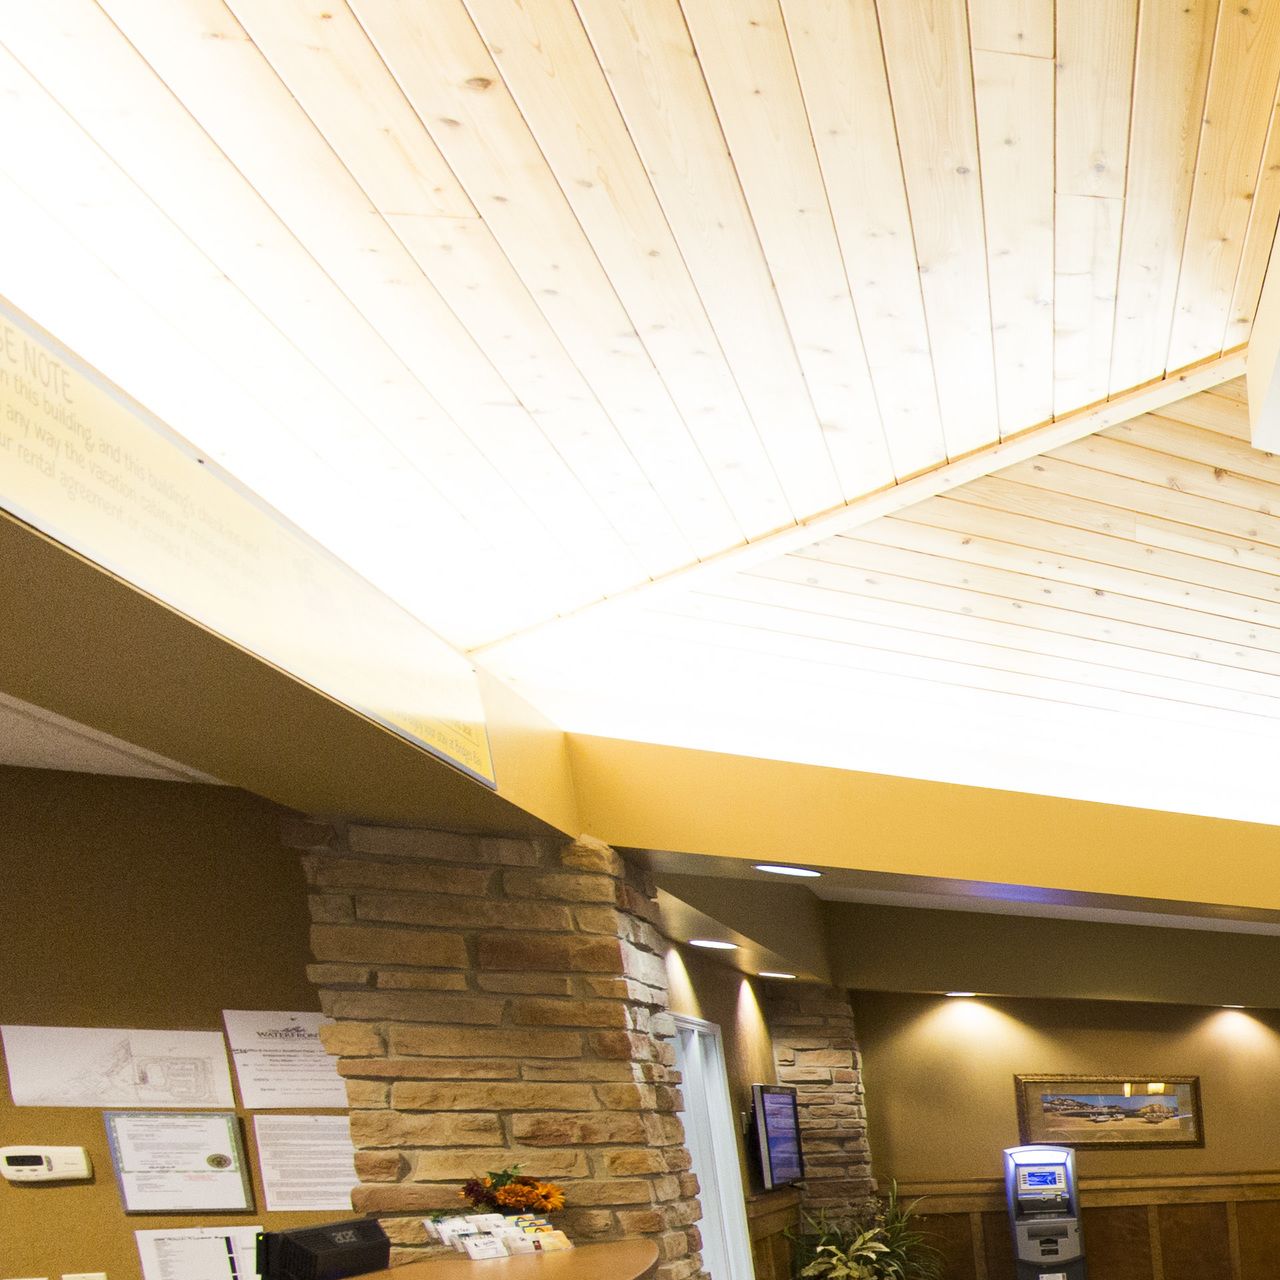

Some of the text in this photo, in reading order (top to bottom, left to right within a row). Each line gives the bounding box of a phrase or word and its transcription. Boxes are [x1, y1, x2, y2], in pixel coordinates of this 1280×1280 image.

[23, 340, 74, 405] NOTE
[6, 405, 31, 438] any
[32, 421, 61, 457] way
[64, 438, 85, 469] the
[88, 458, 137, 501] vacation
[14, 375, 40, 407] this
[98, 436, 121, 465] and
[124, 449, 146, 481] this
[18, 443, 56, 479] rental
[60, 472, 124, 523] agreement
[256, 1031, 320, 1039] WATERFRON
[331, 1230, 357, 1244] acer
